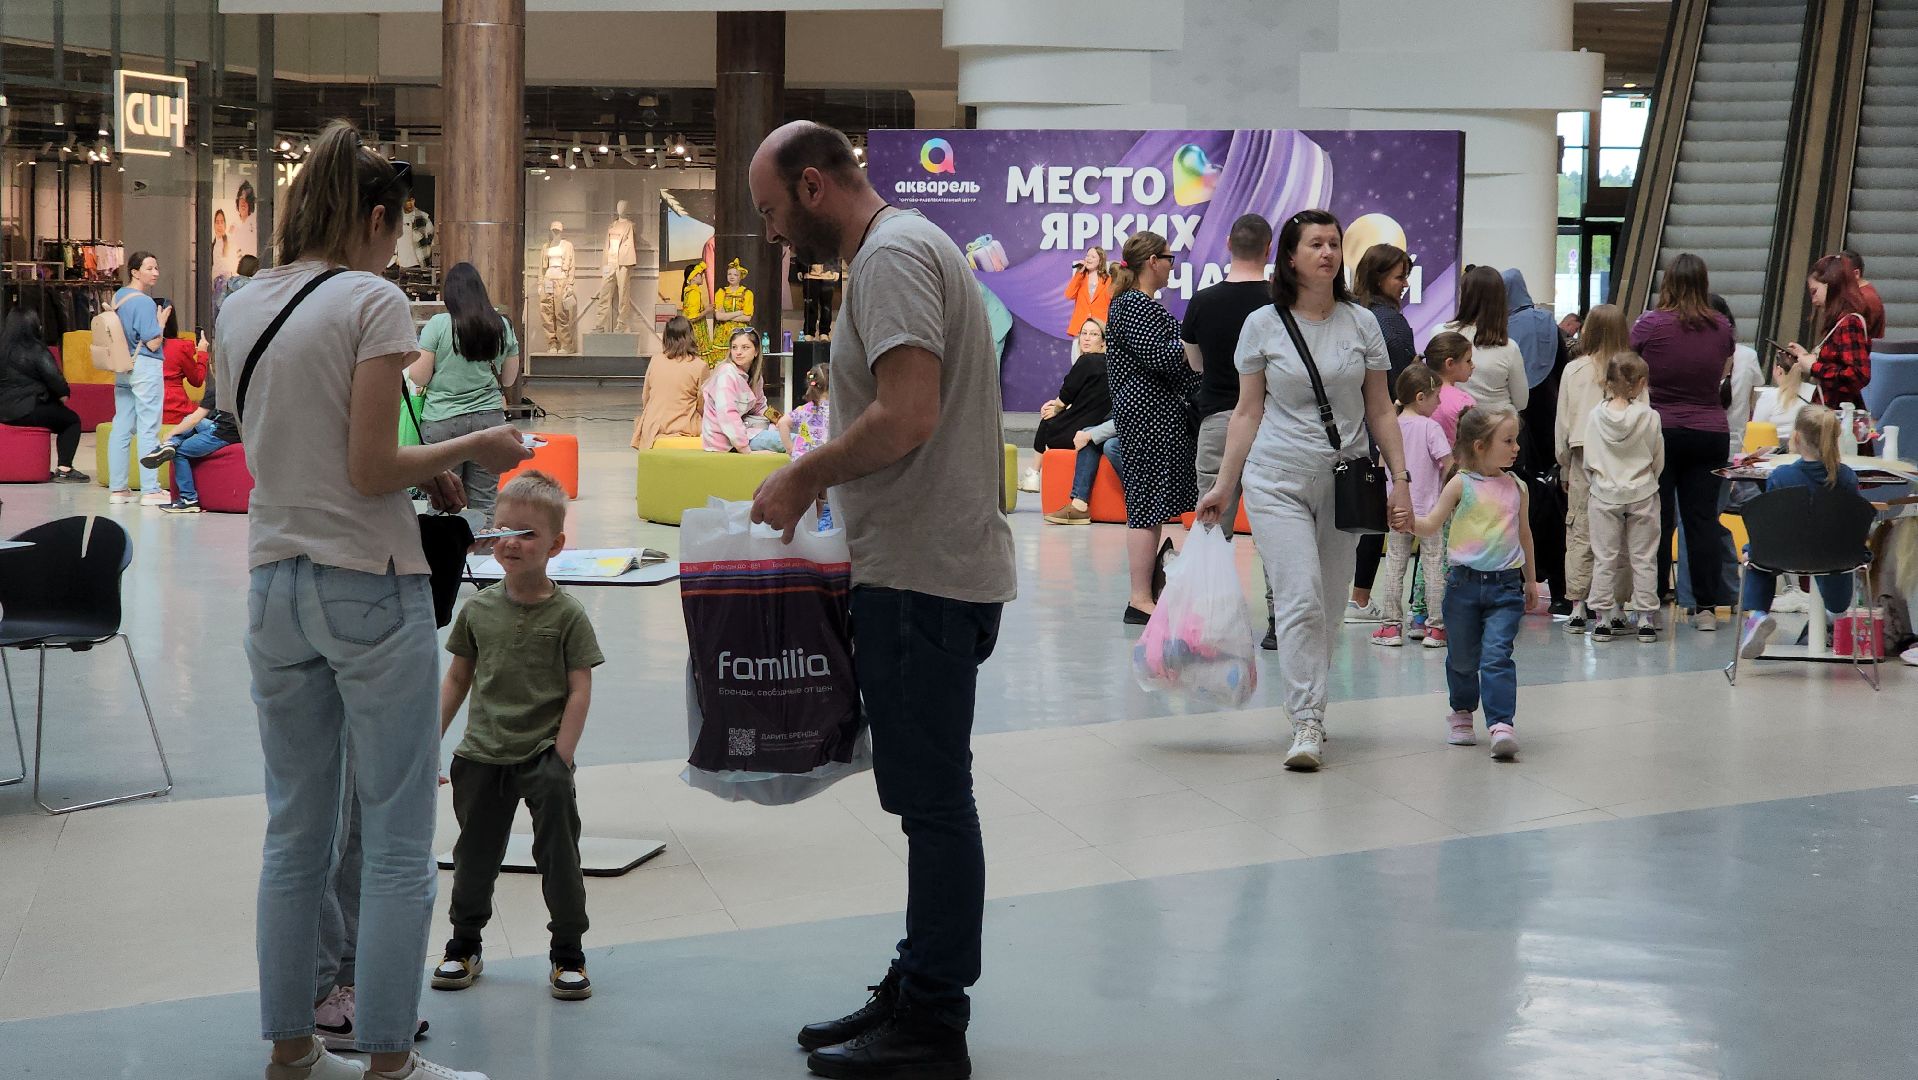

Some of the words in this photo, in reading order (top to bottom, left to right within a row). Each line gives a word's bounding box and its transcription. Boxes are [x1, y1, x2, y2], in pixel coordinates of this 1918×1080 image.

[894, 180, 981, 196] акварель
[1006, 165, 1166, 206] МЕСТО
[718, 647, 831, 681] familia
[804, 686, 814, 694] от
[816, 685, 833, 694] цен
